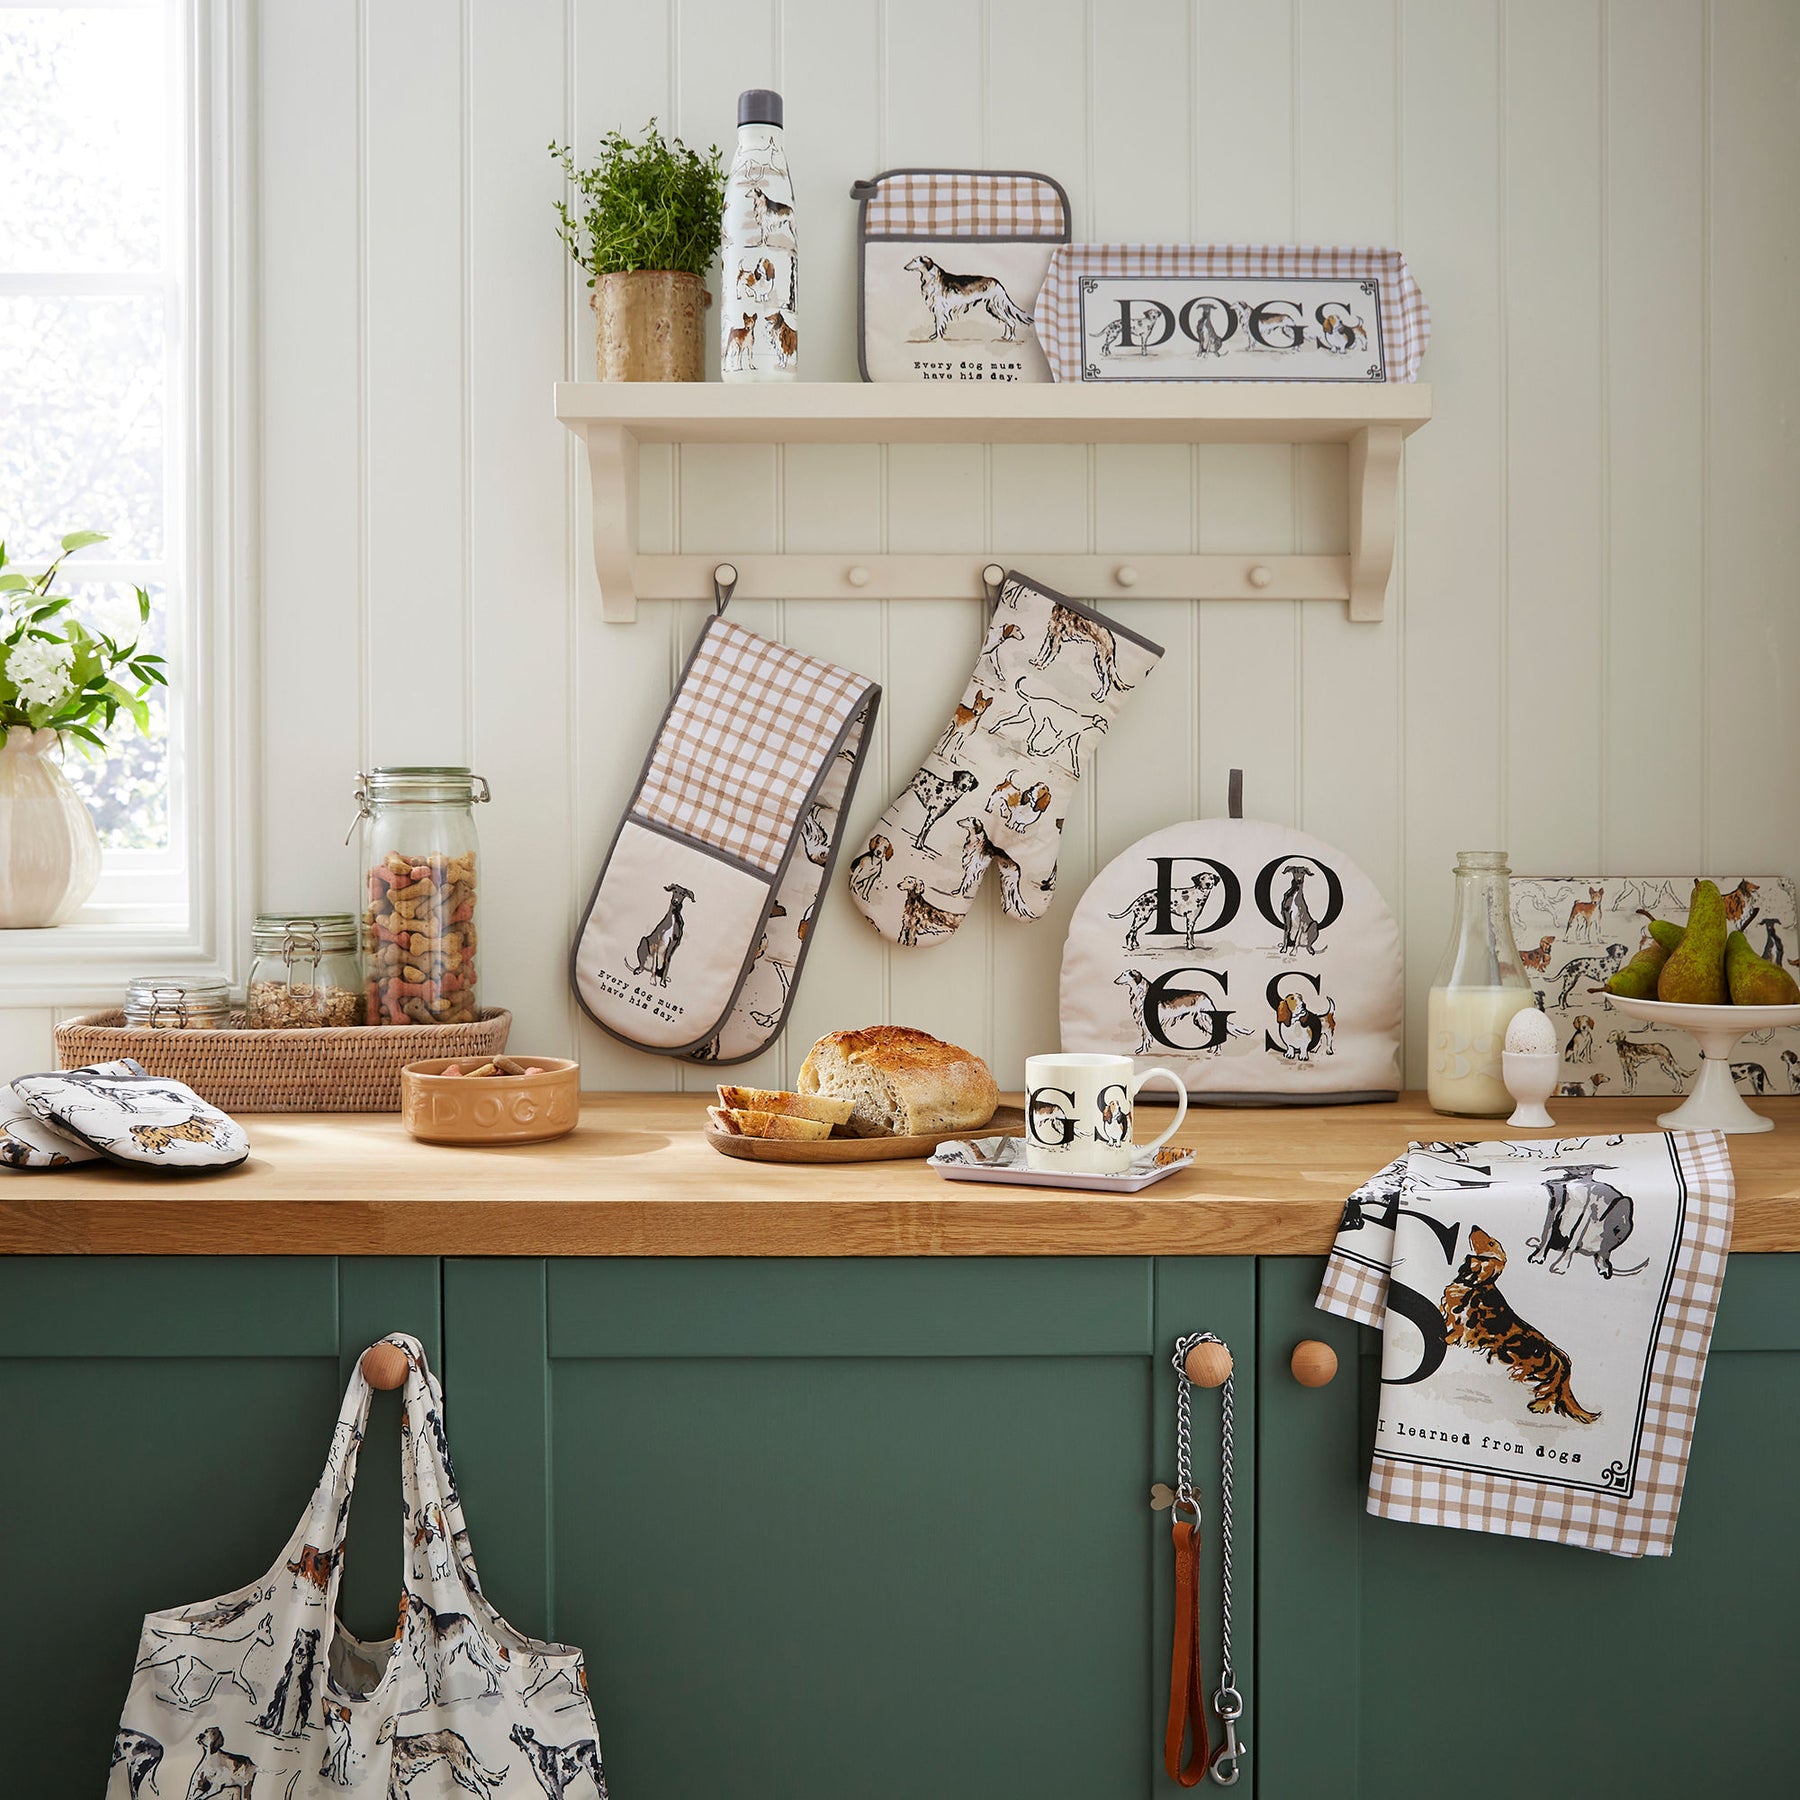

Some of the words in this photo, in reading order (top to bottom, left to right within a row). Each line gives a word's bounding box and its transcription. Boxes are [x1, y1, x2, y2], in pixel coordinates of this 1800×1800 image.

[1113, 296, 1356, 350] DOGS
[914, 361, 953, 371] Every
[960, 361, 983, 371] dog
[990, 362, 1022, 370] must
[923, 372, 953, 380] have
[960, 372, 983, 380] his
[990, 372, 1018, 382] day.
[598, 969, 630, 990] Every
[634, 987, 653, 1002] dog
[657, 998, 685, 1015] must
[600, 982, 624, 999] have
[628, 995, 648, 1010] his
[653, 1007, 675, 1023] day.
[432, 1090, 539, 1127] DOG
[1377, 1419, 1386, 1432] I
[1397, 1422, 1470, 1446] learned
[1481, 1436, 1524, 1455] from
[1535, 1445, 1582, 1464] dogs
